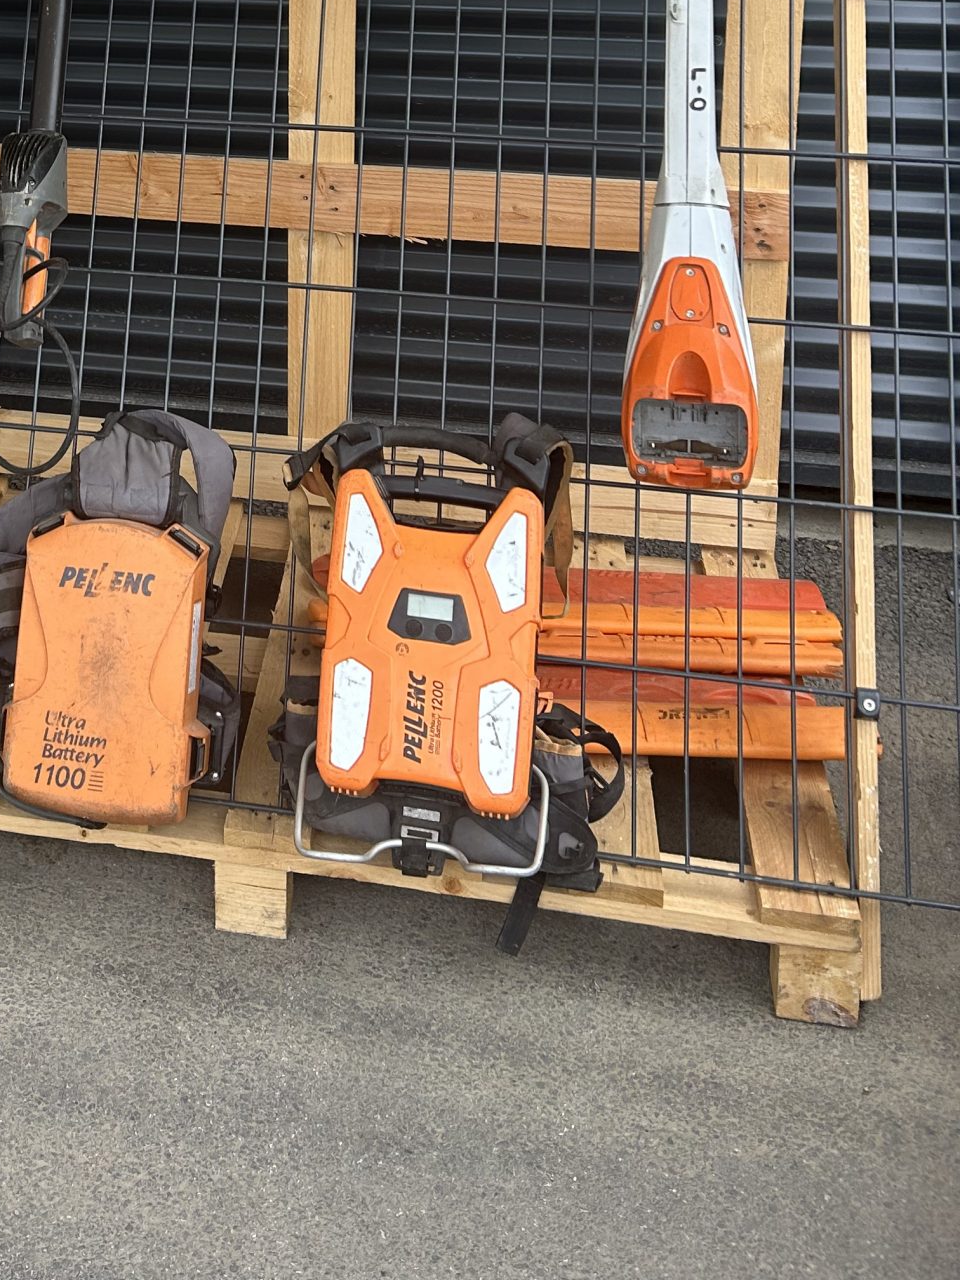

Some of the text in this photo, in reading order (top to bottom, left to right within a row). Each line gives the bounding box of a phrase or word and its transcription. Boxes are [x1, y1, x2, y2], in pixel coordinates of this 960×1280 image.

[431, 680, 444, 712] 1200
[45, 710, 86, 730] Ultra
[402, 670, 428, 764] PELLENC
[43, 727, 107, 749] Lithium
[42, 743, 105, 768] Battery
[34, 763, 86, 789] 1100
